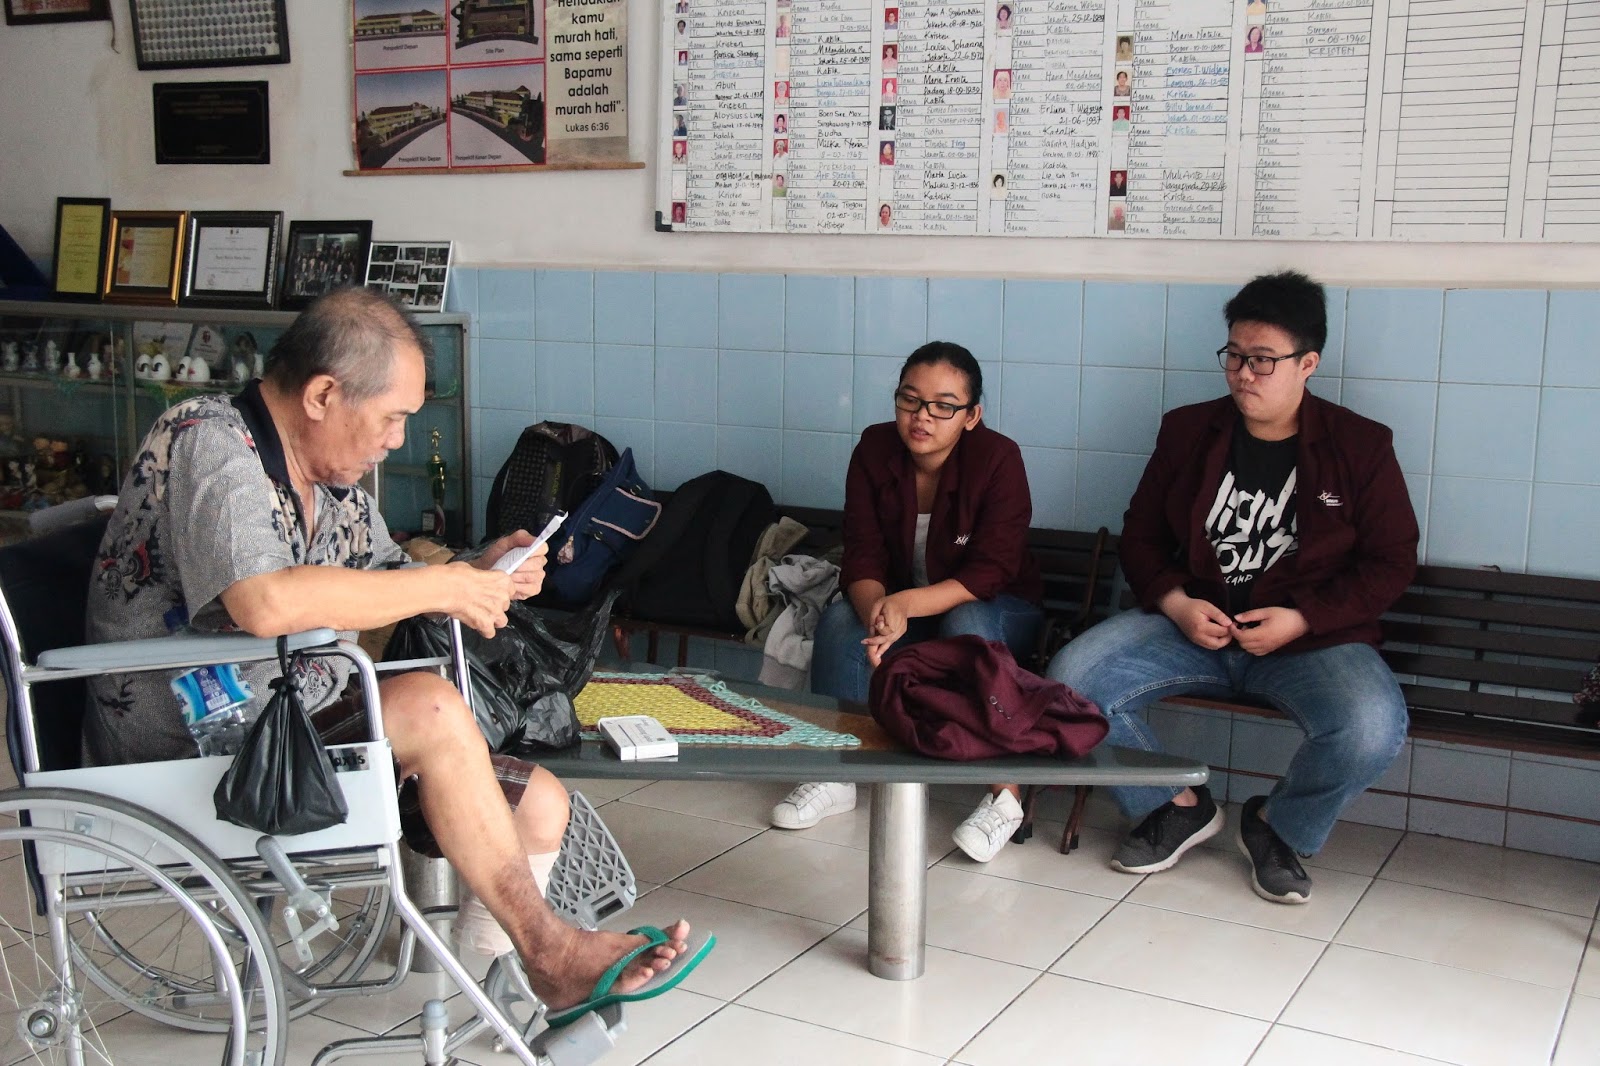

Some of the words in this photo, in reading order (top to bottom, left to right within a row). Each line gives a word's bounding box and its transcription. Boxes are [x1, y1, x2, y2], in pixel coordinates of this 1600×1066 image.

[571, 12, 605, 25] kamu
[554, 29, 592, 44] murah
[594, 27, 618, 41] hati,
[1171, 30, 1195, 41] Maria
[550, 51, 582, 62] sama
[585, 45, 623, 61] seperti
[1309, 46, 1355, 57] KRISTEN
[564, 67, 613, 81] Bapamu
[568, 83, 609, 97] adalah
[555, 102, 593, 115] murah
[565, 123, 590, 132] Lukas
[590, 122, 610, 131] 6:36
[947, 170, 968, 180] Lucia
[923, 190, 952, 200] Katolik
